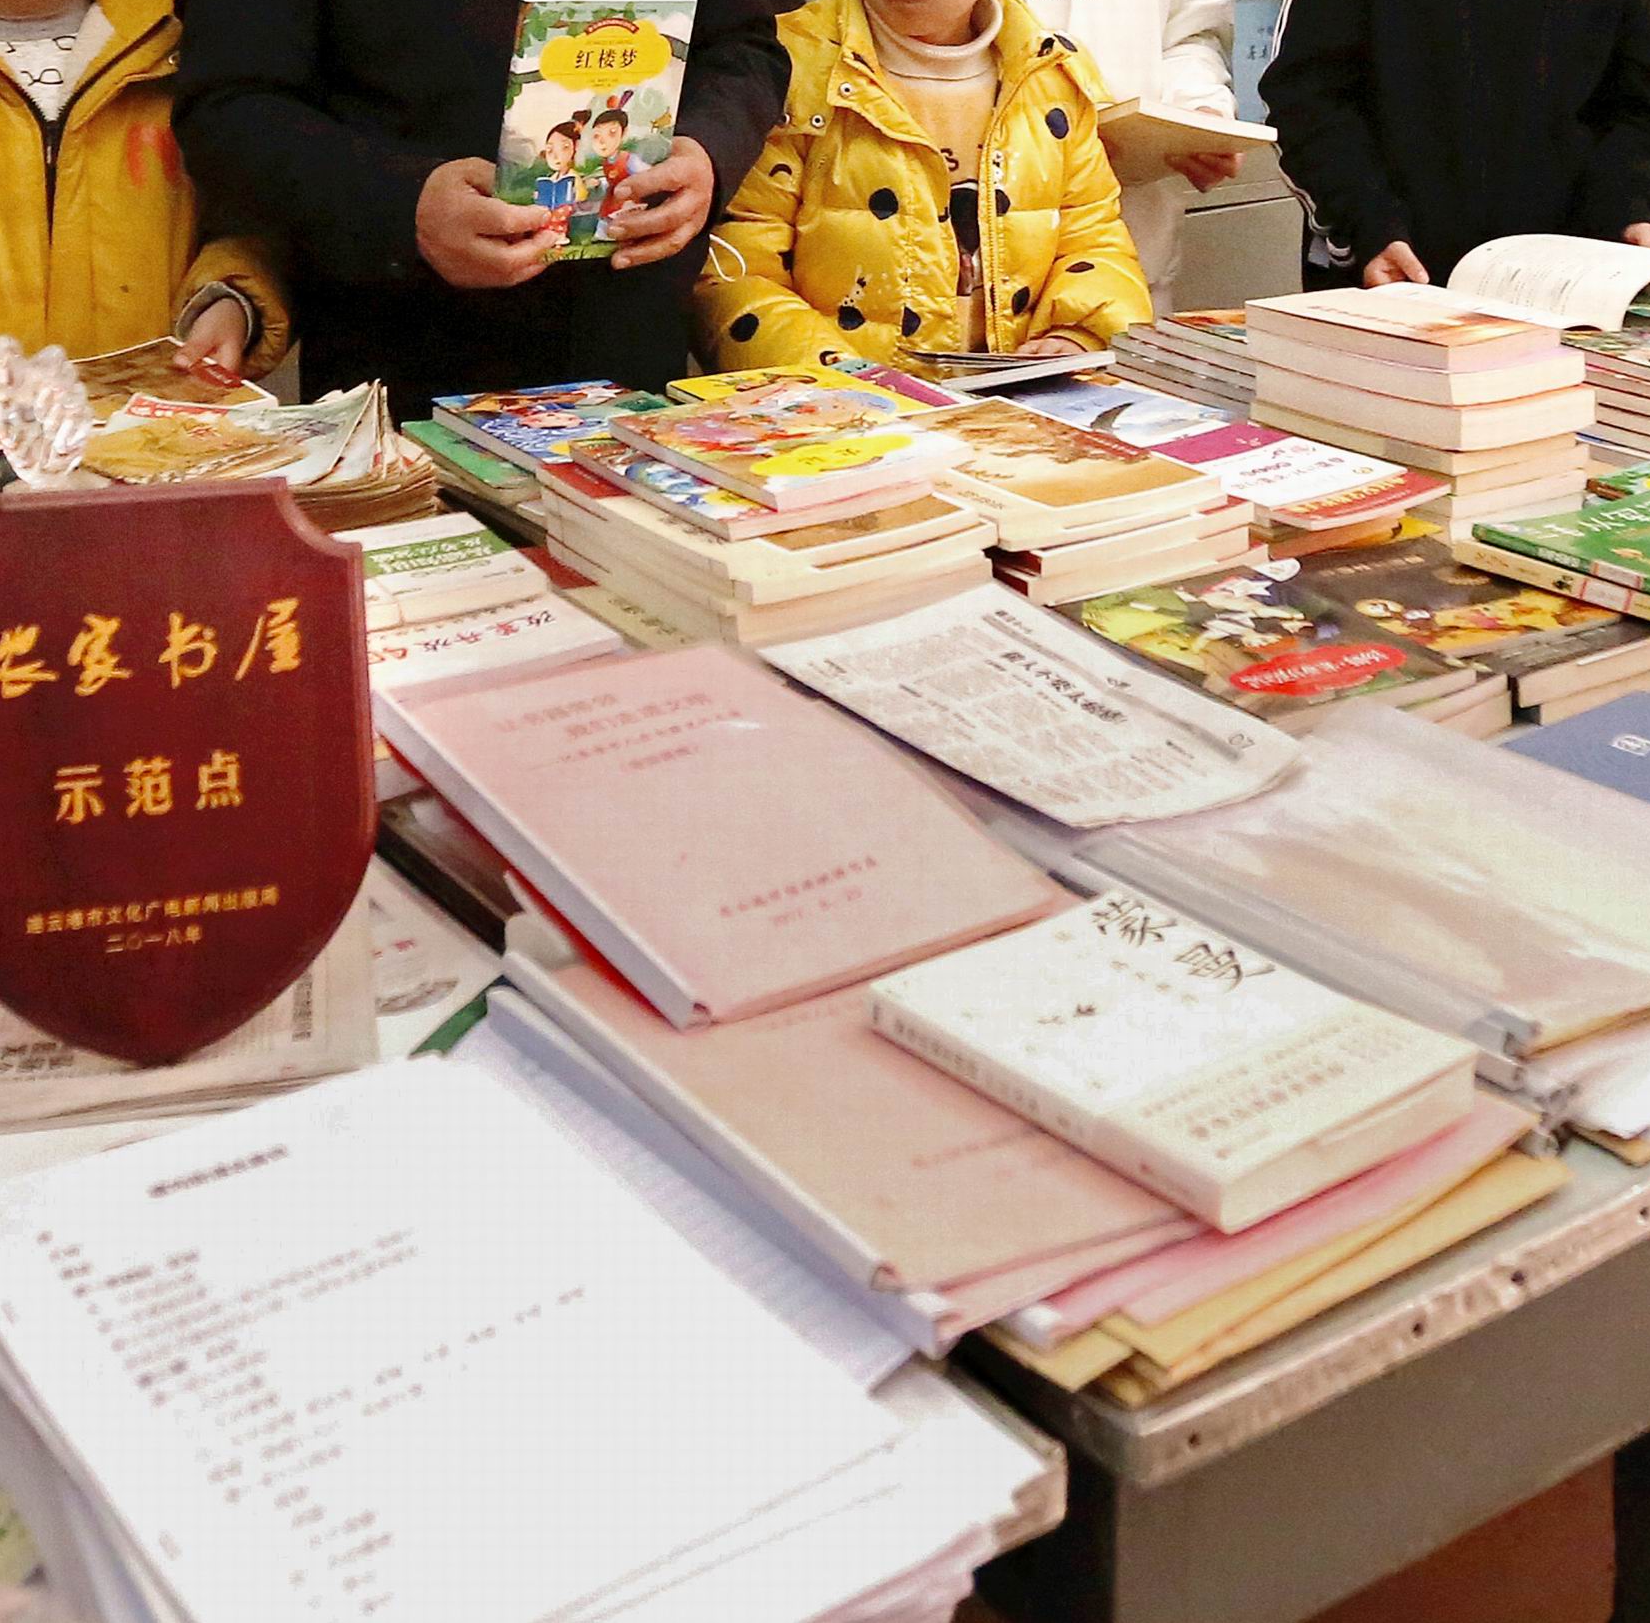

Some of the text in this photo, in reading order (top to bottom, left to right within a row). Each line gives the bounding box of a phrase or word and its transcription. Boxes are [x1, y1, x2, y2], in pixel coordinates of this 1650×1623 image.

[575, 48, 638, 69] 红楼梦
[53, 750, 244, 824] 示范点
